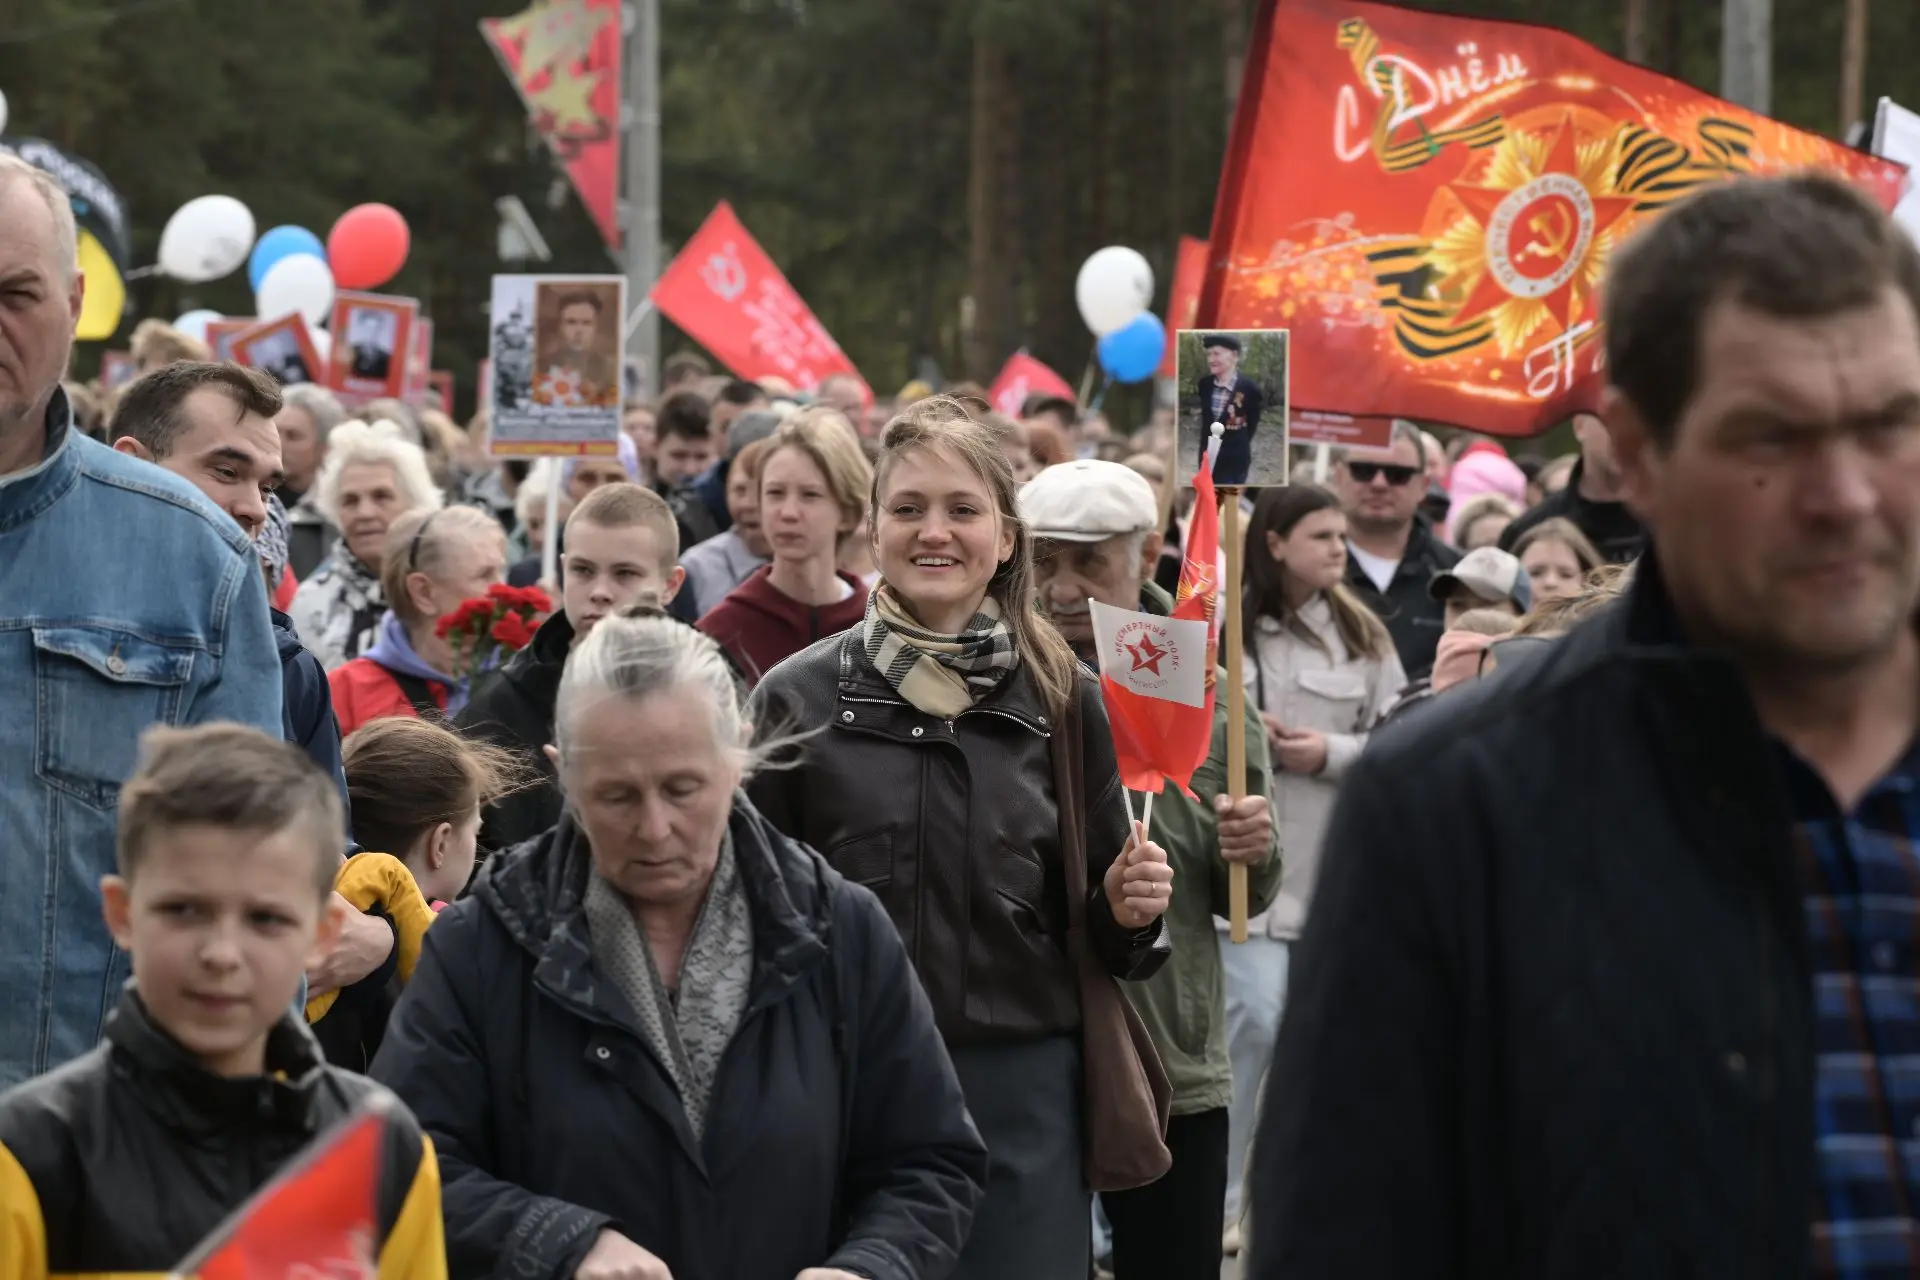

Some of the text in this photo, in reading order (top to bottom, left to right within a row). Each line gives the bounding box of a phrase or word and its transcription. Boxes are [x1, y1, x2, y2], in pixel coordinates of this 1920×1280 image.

[1334, 41, 1529, 163] С Днём
[1115, 621, 1180, 669] БЕССМЕРТНЫЙ ПОЛК
